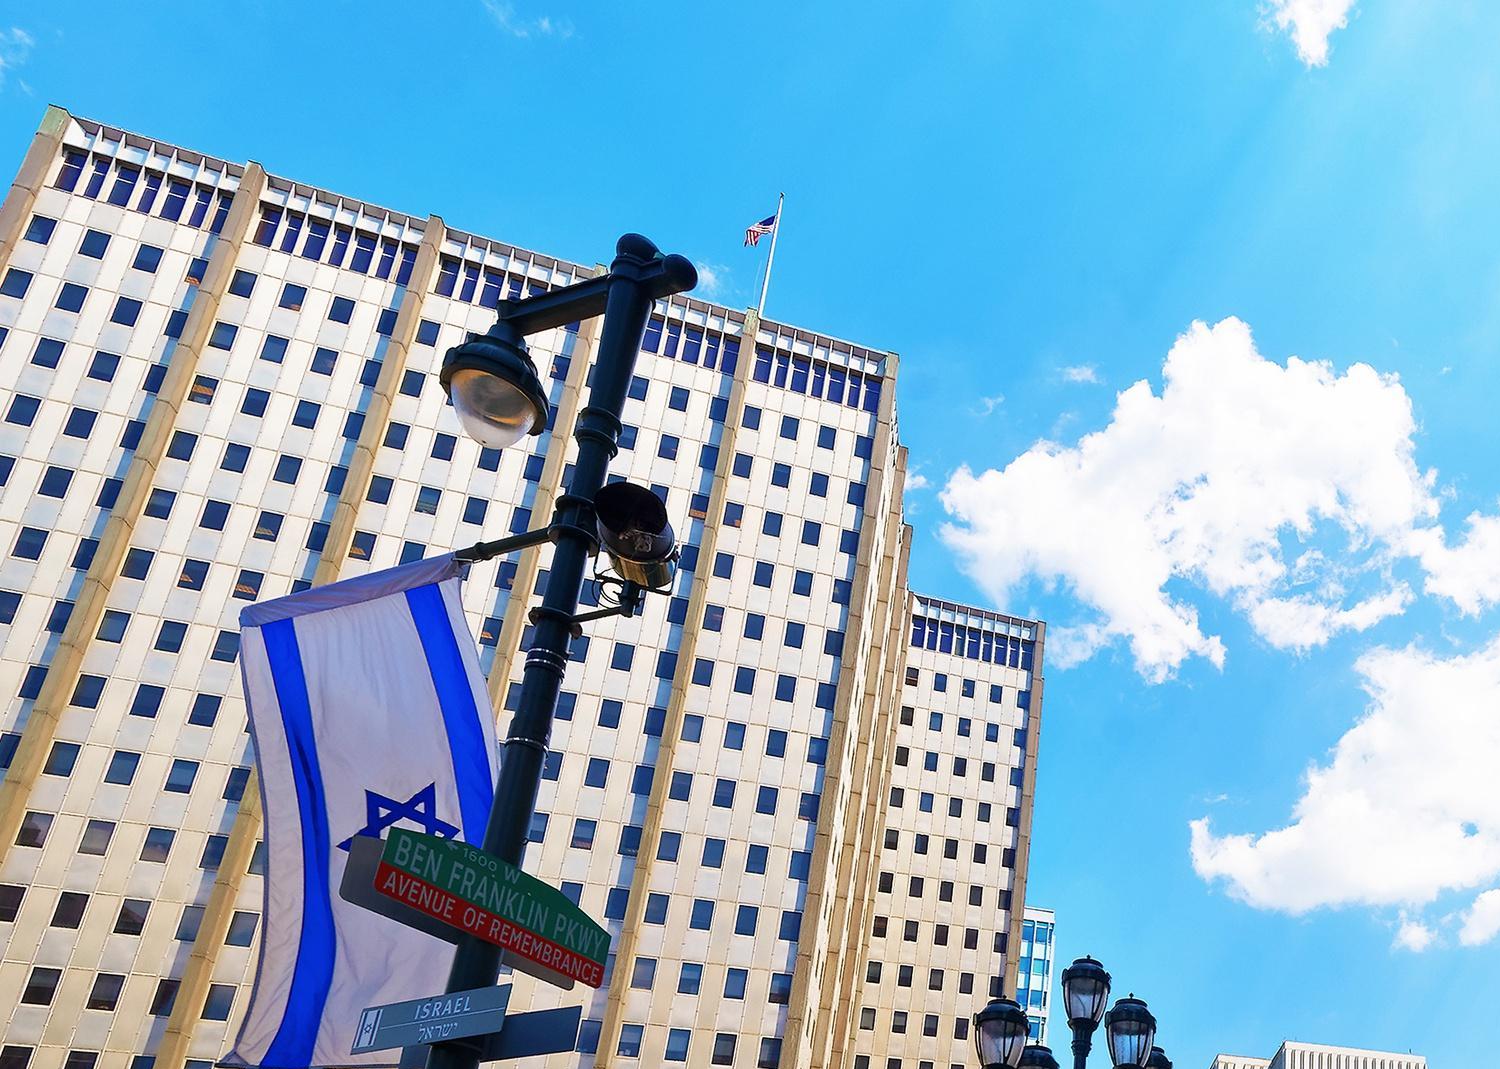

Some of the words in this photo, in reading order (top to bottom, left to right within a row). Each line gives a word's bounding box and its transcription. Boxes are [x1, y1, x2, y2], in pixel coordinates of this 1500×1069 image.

[463, 848, 498, 872] 1600
[504, 865, 521, 884] W
[394, 834, 444, 882] BEN
[447, 861, 549, 934] FRANKLIN
[553, 913, 605, 959] PKWY
[383, 871, 456, 919] AVENUE
[463, 907, 487, 931] OF
[489, 918, 600, 985] REMEMBRANCE
[414, 996, 471, 1020] ISRAEL
[418, 1022, 459, 1041] ישראל
